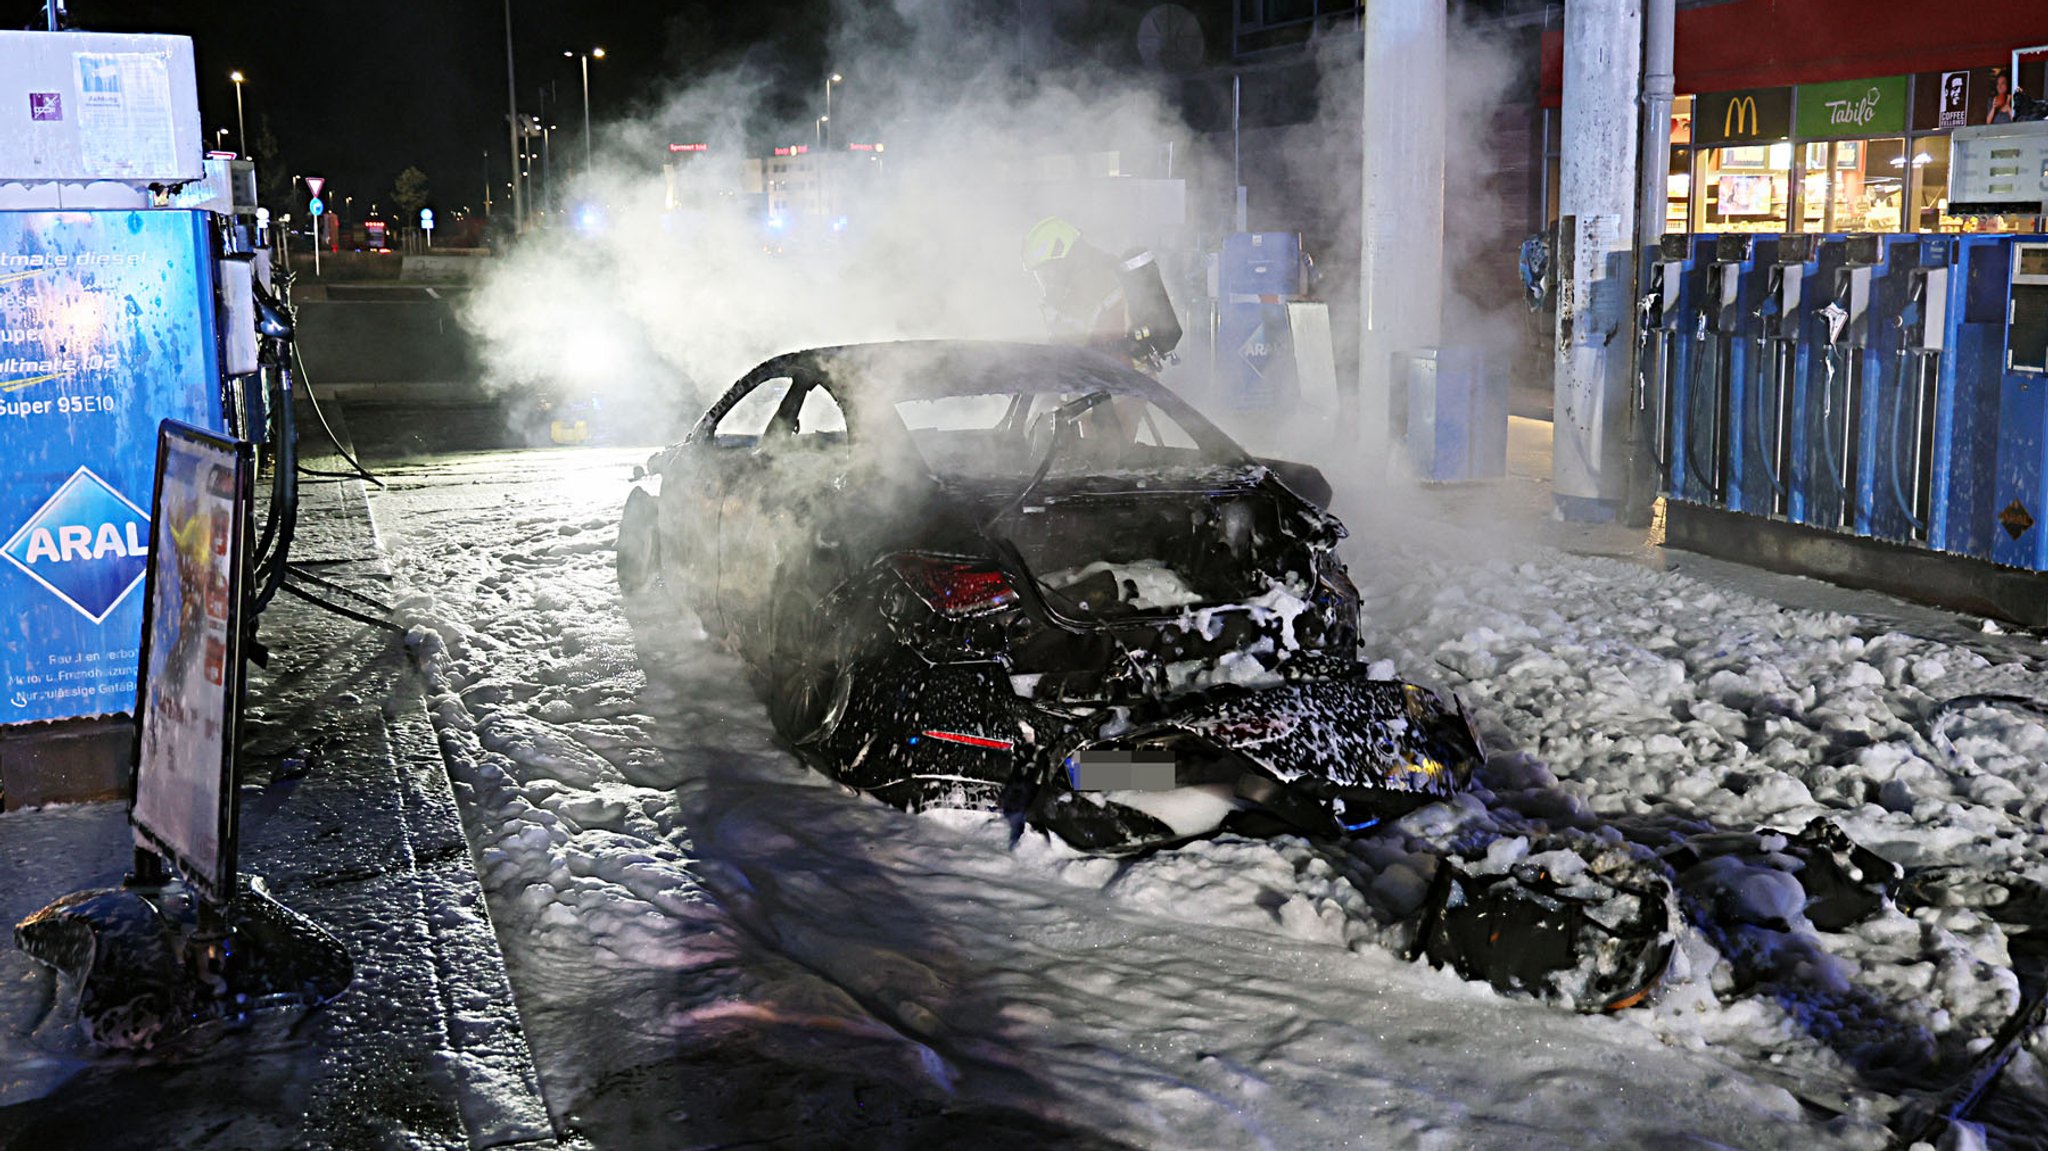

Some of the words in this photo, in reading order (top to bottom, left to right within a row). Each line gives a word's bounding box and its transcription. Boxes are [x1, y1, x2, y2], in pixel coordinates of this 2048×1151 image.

[1941, 110, 1965, 121] COFFEE
[0, 398, 52, 418] Super
[26, 521, 149, 564] ARAL
